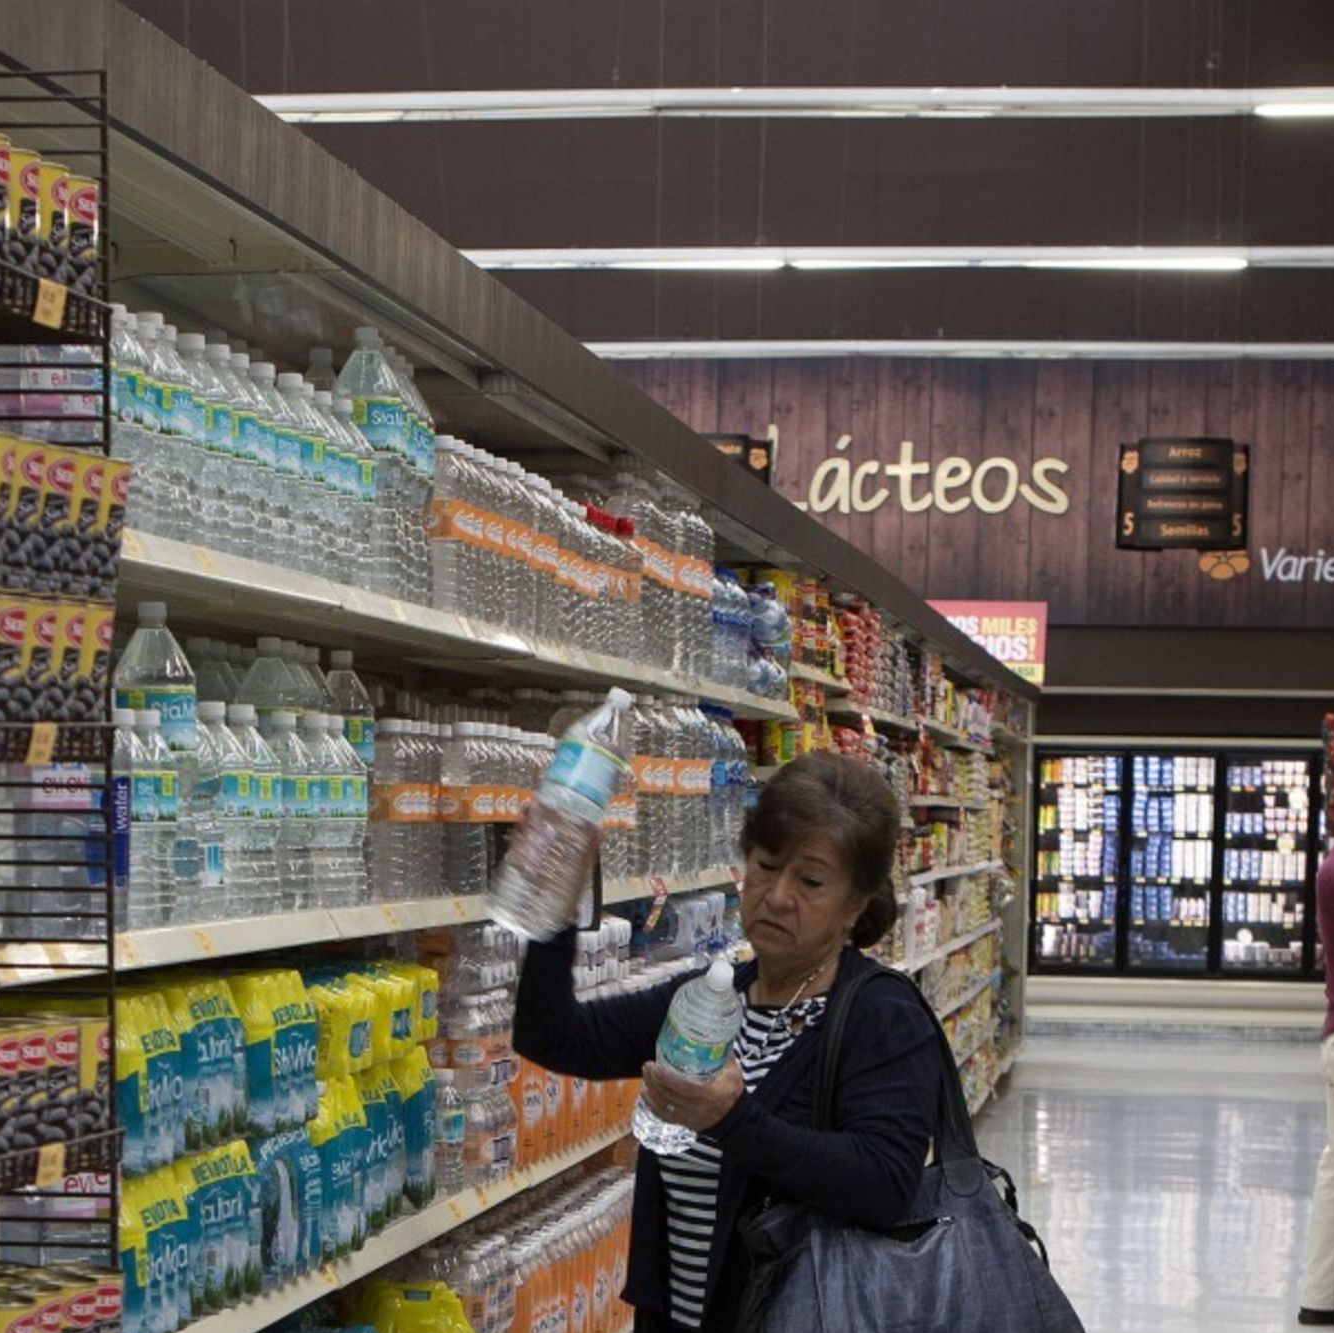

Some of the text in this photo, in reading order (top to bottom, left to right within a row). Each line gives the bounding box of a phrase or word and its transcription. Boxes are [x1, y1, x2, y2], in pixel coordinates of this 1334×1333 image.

[1168, 447, 1203, 458] Arroz
[1123, 512, 1134, 536] 5
[1160, 523, 1209, 537] Semillas
[1232, 513, 1242, 536] 5
[981, 617, 1037, 637] MILES
